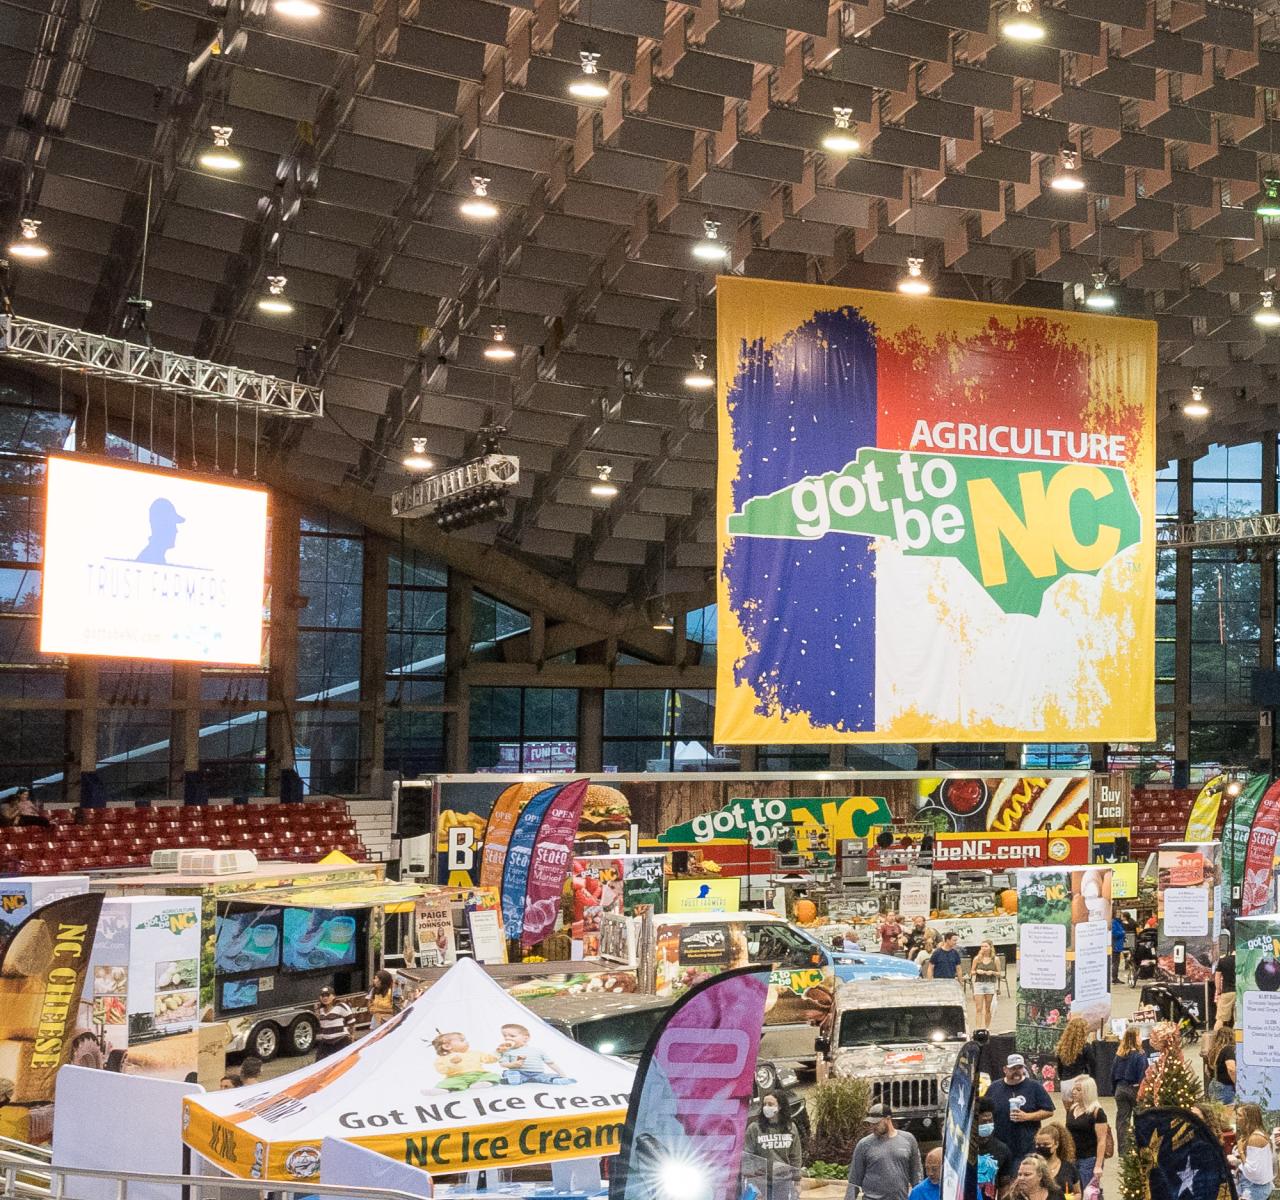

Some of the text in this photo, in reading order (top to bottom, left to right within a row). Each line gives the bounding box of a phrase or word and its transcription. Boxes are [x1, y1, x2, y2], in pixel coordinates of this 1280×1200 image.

[910, 420, 1126, 461] AGRICULTURE
[792, 453, 957, 536] got to
[892, 497, 965, 551] be
[967, 463, 1122, 587] NC
[88, 563, 228, 608] TRUST FARMERS
[1262, 711, 1270, 725] 1
[1101, 786, 1121, 804] Buy
[551, 808, 576, 819] OPEN
[692, 799, 786, 842] got to
[792, 797, 879, 858] NC
[1251, 831, 1275, 846] State
[536, 848, 568, 866] State
[534, 869, 562, 882] Market
[1046, 884, 1066, 900] NC
[169, 911, 197, 930] NC
[421, 910, 447, 920] PAIGE
[418, 920, 451, 929] JOHNSON
[1248, 935, 1272, 950] got to
[1262, 943, 1273, 952] be
[791, 970, 821, 990] NC
[31, 923, 88, 1069] NC CHEESE
[339, 1111, 393, 1129] Got
[419, 1102, 469, 1124] NC
[474, 1096, 526, 1118] Ice
[405, 1121, 625, 1167] NC Ice Cream
[774, 1141, 792, 1149] CAMP
